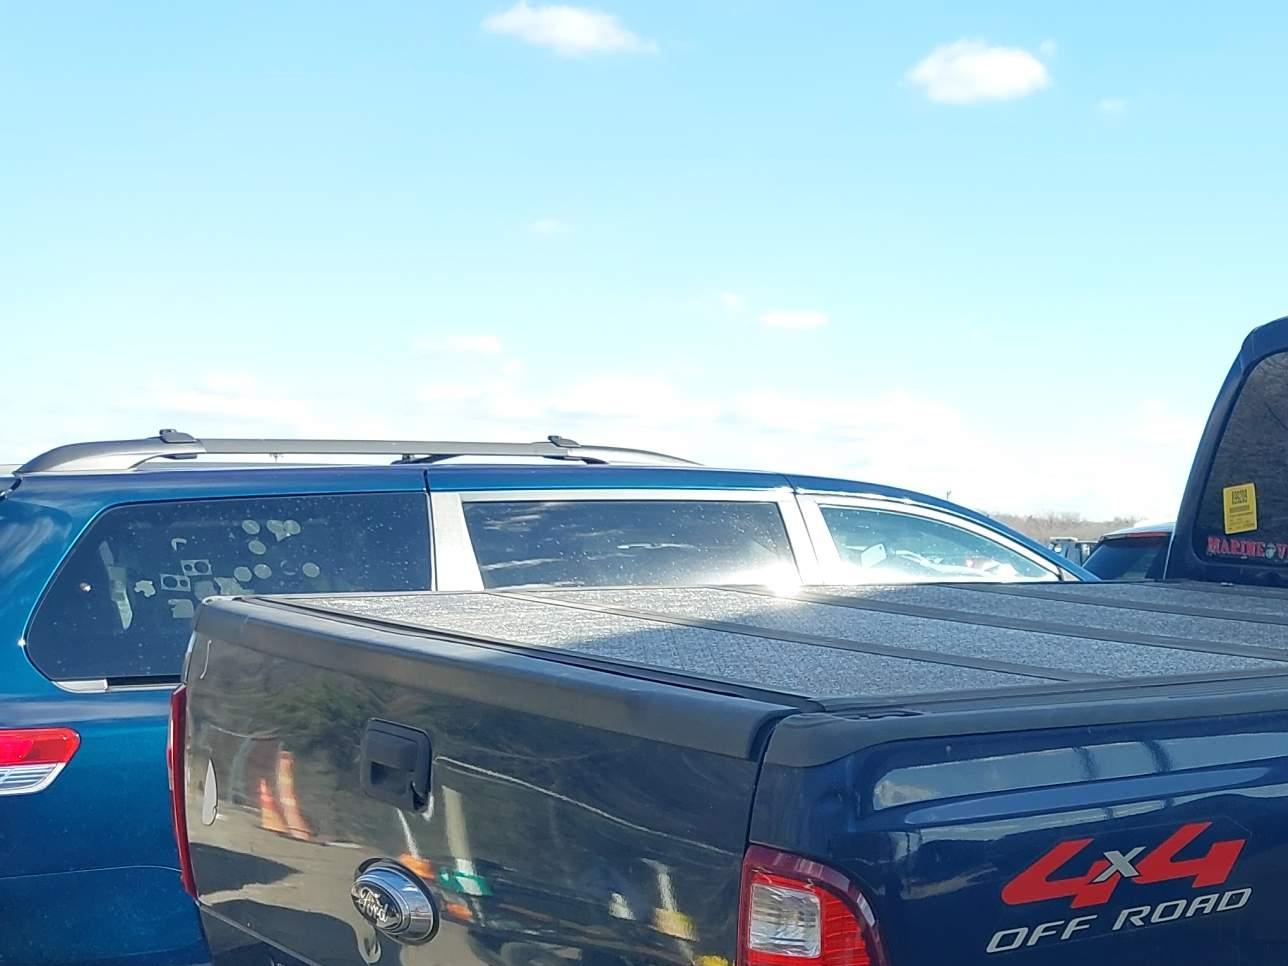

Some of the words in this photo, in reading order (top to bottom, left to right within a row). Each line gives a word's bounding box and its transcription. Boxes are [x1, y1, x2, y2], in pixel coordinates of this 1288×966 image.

[1207, 536, 1266, 557] MARINE
[356, 886, 389, 923] Ford
[986, 914, 1098, 953] OFF
[1112, 887, 1252, 930] ROAD
